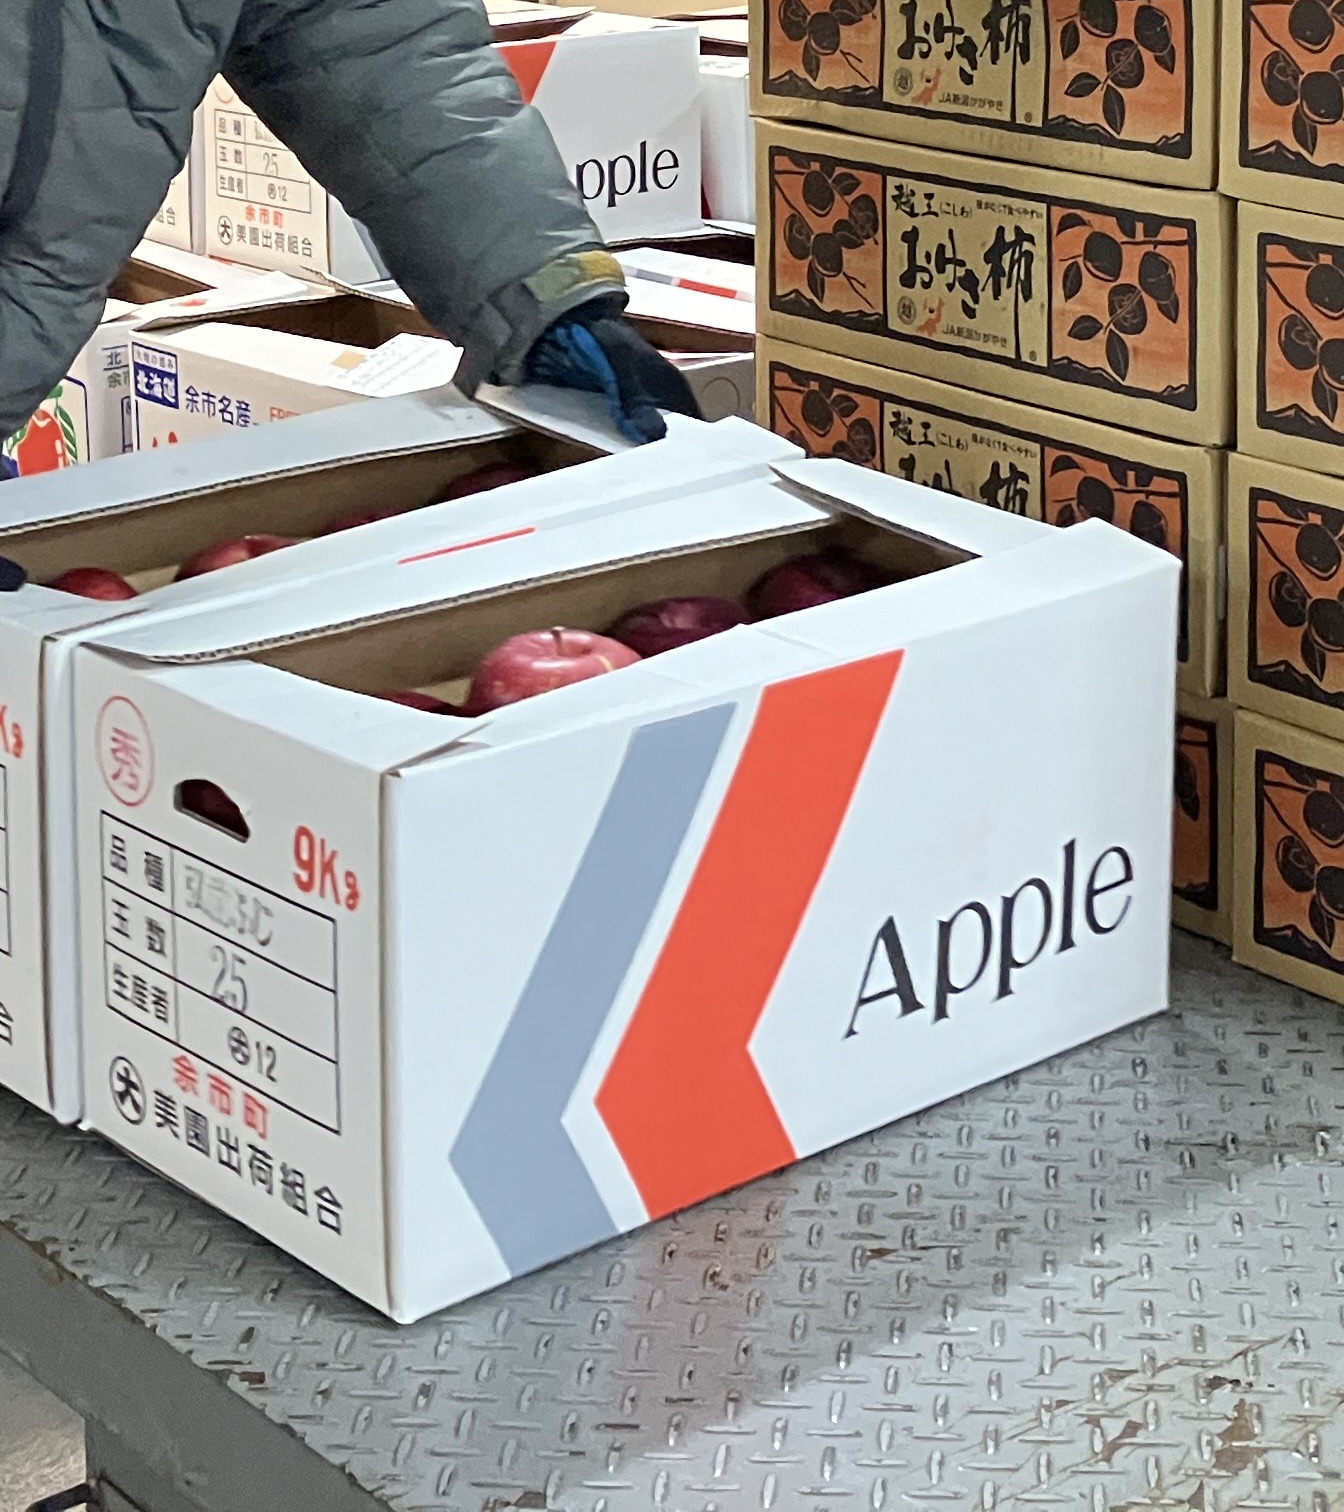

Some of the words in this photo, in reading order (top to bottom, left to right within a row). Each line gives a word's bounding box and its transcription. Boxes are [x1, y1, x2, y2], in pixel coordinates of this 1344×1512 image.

[219, 145, 242, 165] 玉数
[576, 140, 681, 208] pple
[236, 223, 313, 258] 美園出荷組合
[245, 204, 284, 229] 余市町
[899, 224, 1035, 361] おけさ柿
[136, 368, 177, 403] 北海道
[185, 385, 251, 427] 余市名産
[107, 727, 145, 785] 秀
[108, 833, 165, 897] 品種
[291, 825, 361, 912] 9Kg
[110, 897, 168, 958] 玉数
[208, 943, 249, 1015] 25
[842, 836, 1135, 1041] Apple
[111, 963, 171, 1025] 生産者
[170, 1053, 269, 1141] 余市町
[152, 1087, 344, 1236] 美園出荷組合
